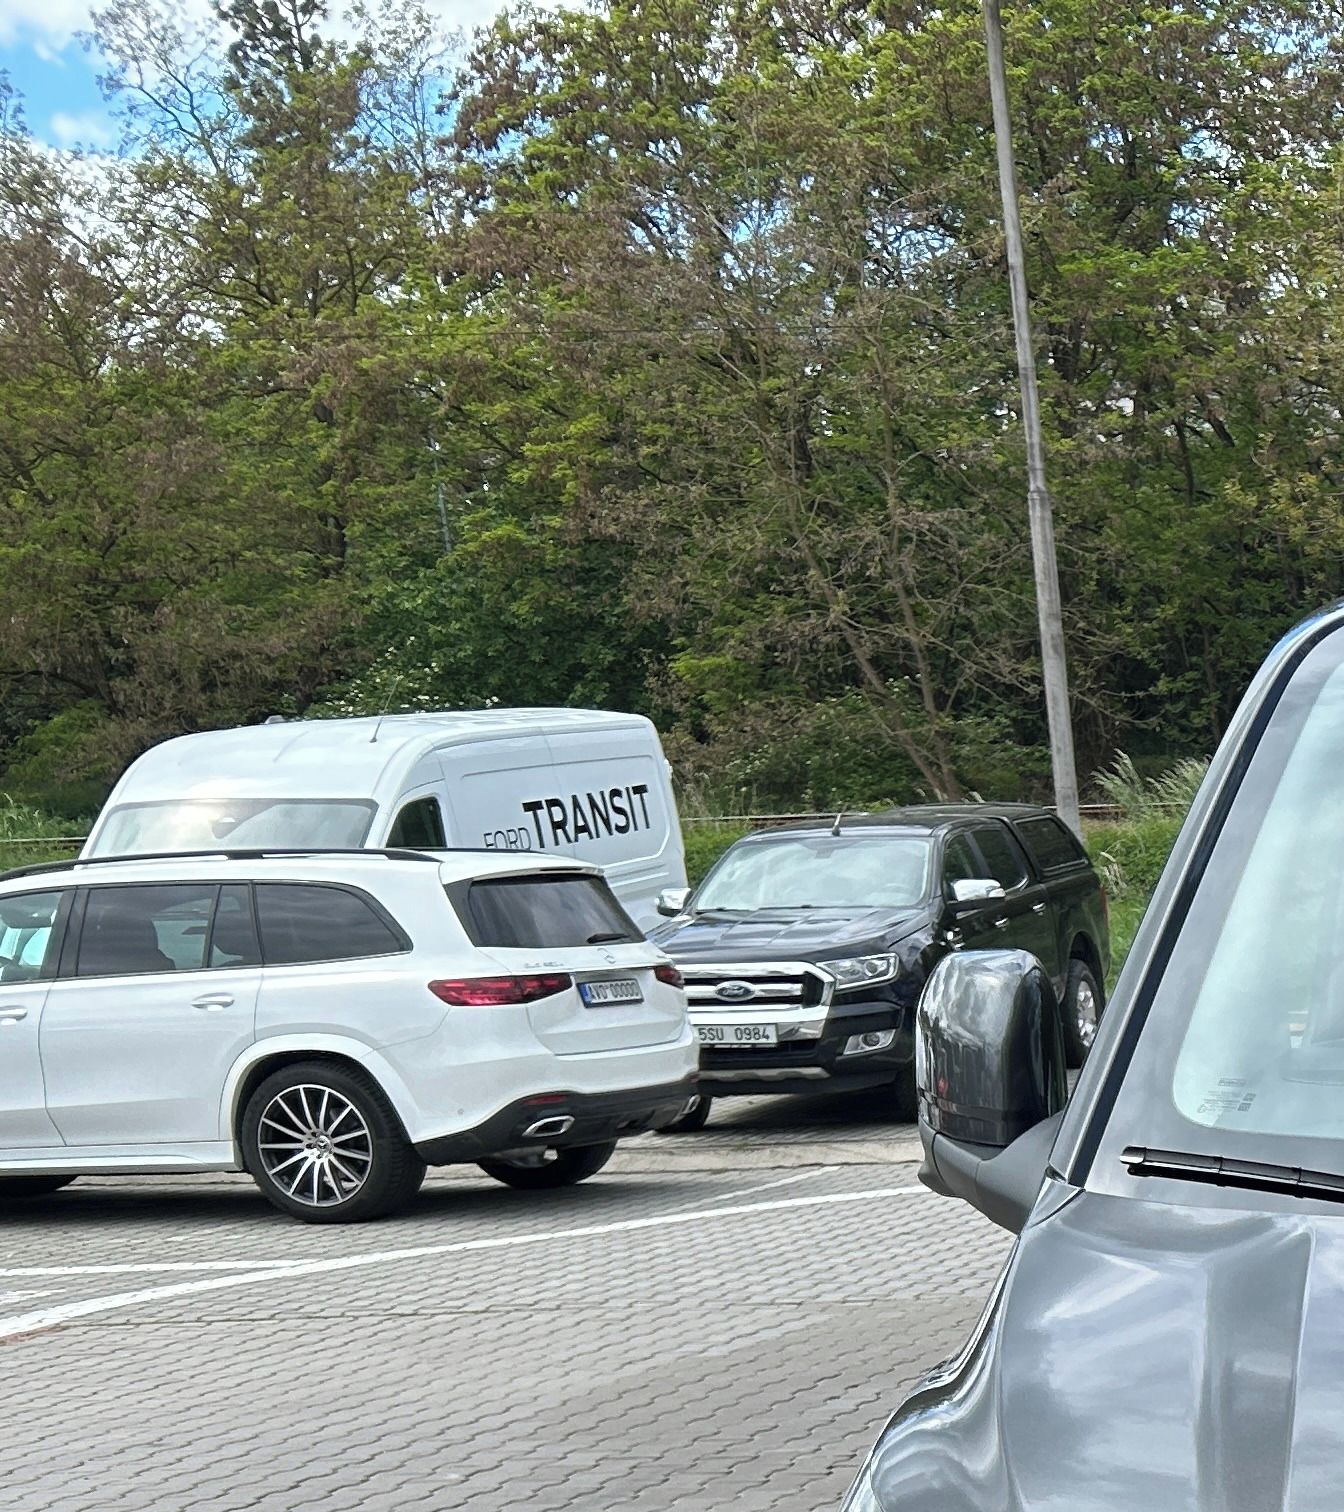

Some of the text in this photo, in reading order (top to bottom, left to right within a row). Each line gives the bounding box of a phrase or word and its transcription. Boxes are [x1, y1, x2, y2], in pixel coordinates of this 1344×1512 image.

[483, 784, 651, 850] FORD TRANSIT
[699, 1027, 771, 1042] 5SU 0984
